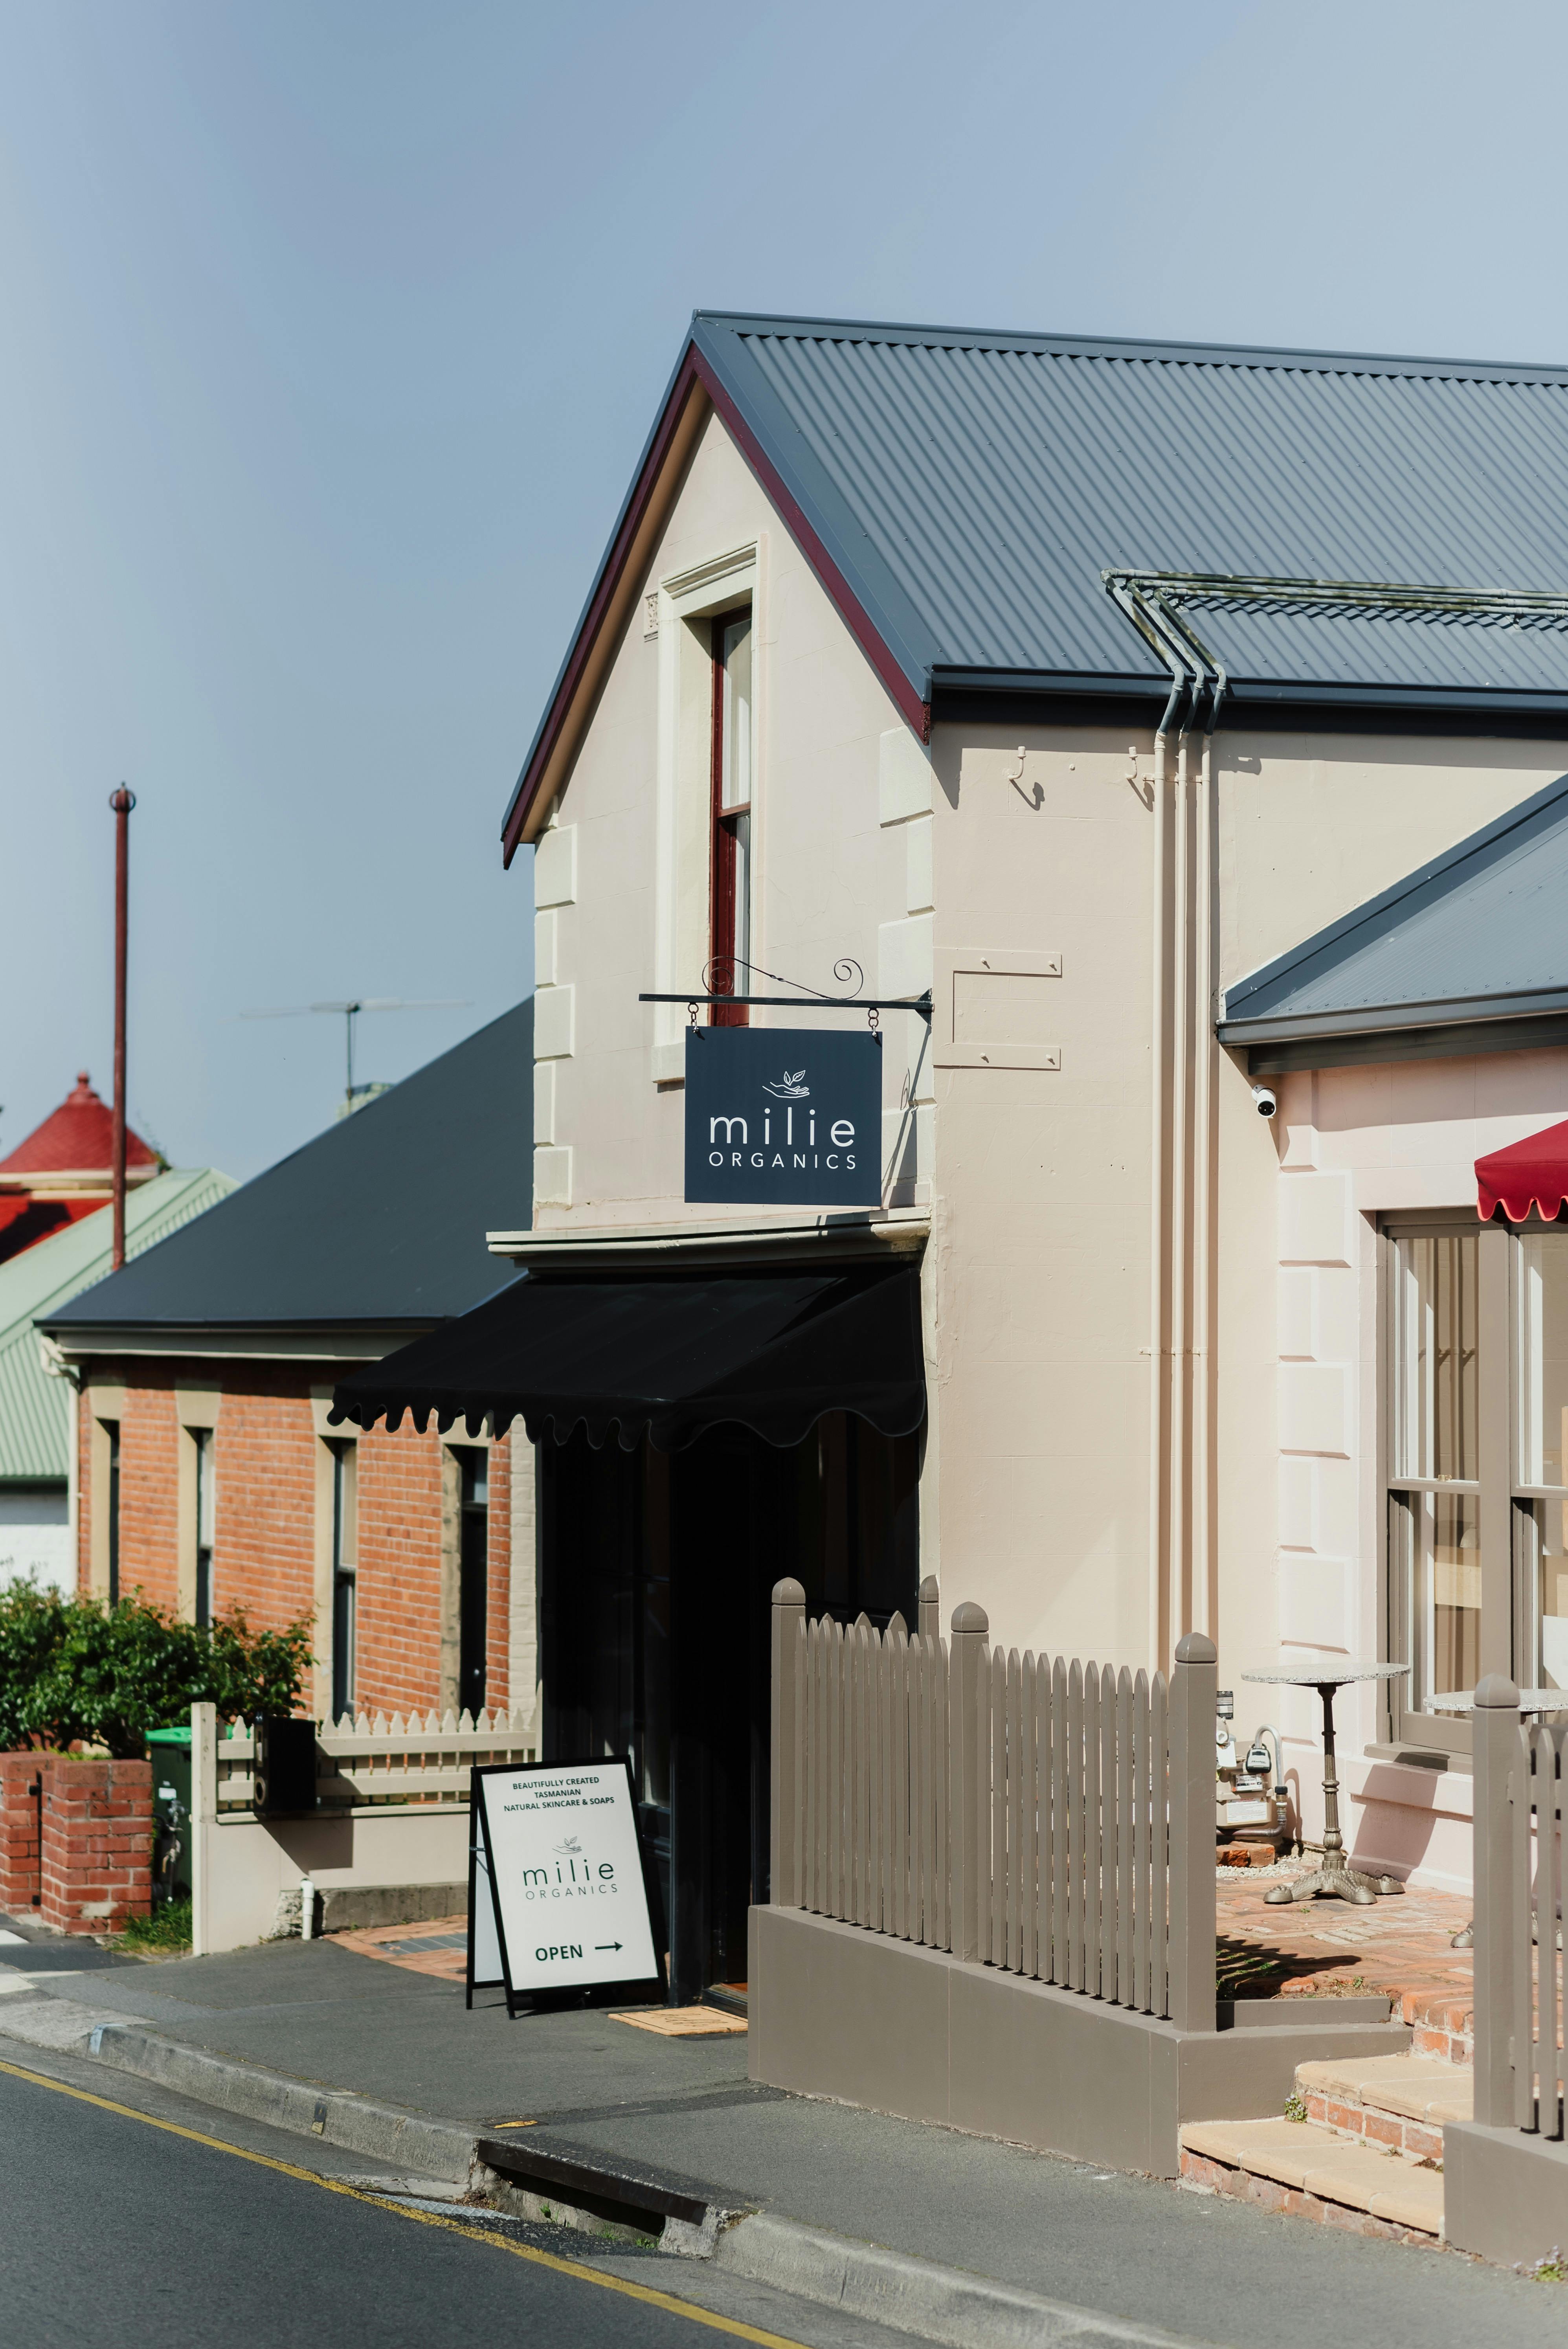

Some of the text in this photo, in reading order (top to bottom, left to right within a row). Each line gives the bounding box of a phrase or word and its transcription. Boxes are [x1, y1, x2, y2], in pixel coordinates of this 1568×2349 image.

[710, 1107, 855, 1147] milie
[709, 1152, 856, 1169] ORGANICS
[513, 1777, 599, 1789] BEAUTIFULLY CREATED
[534, 1789, 581, 1798] TASMANIAN
[504, 1803, 540, 1811] NATURAL
[542, 1799, 580, 1809] SKINCARE
[523, 1859, 614, 1886] milie
[525, 1884, 617, 1900] ORGANICS
[535, 1944, 583, 1961] OPEN
